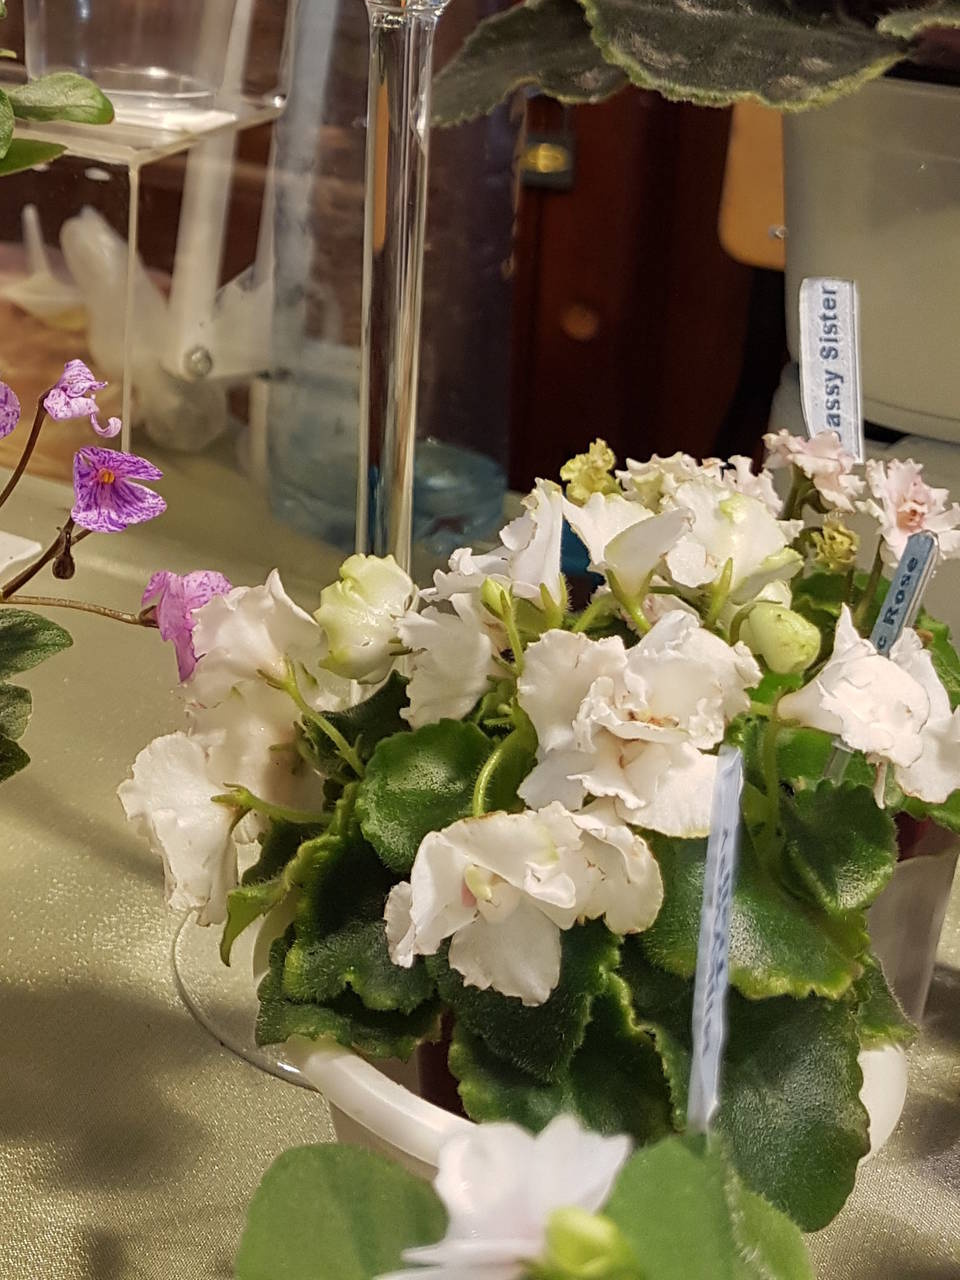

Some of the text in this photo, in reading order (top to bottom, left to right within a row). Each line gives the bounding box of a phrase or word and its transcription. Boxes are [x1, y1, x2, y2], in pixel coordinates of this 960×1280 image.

[819, 283, 844, 429] assy Sister
[882, 556, 918, 626] Rose
